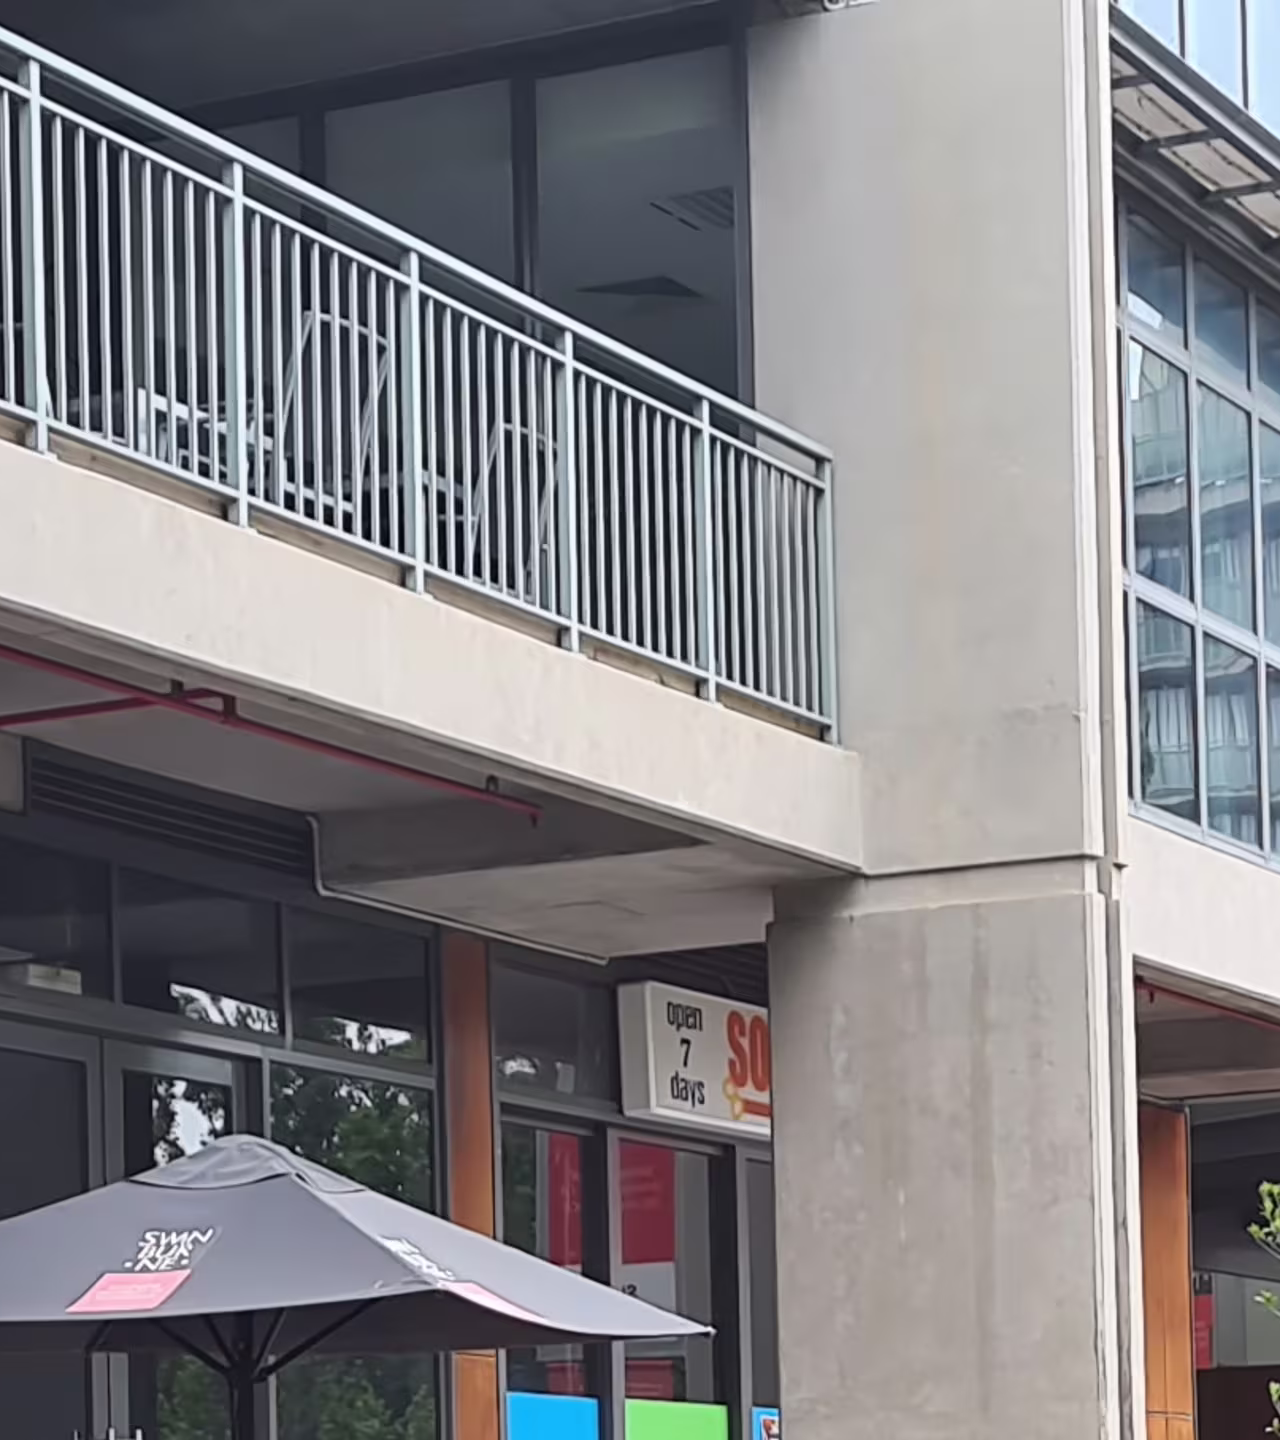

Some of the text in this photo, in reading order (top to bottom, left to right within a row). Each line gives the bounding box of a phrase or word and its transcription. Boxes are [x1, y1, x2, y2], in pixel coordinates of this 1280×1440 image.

[666, 1001, 703, 1032] open
[680, 1037, 692, 1068] 7
[670, 1070, 705, 1108] days
